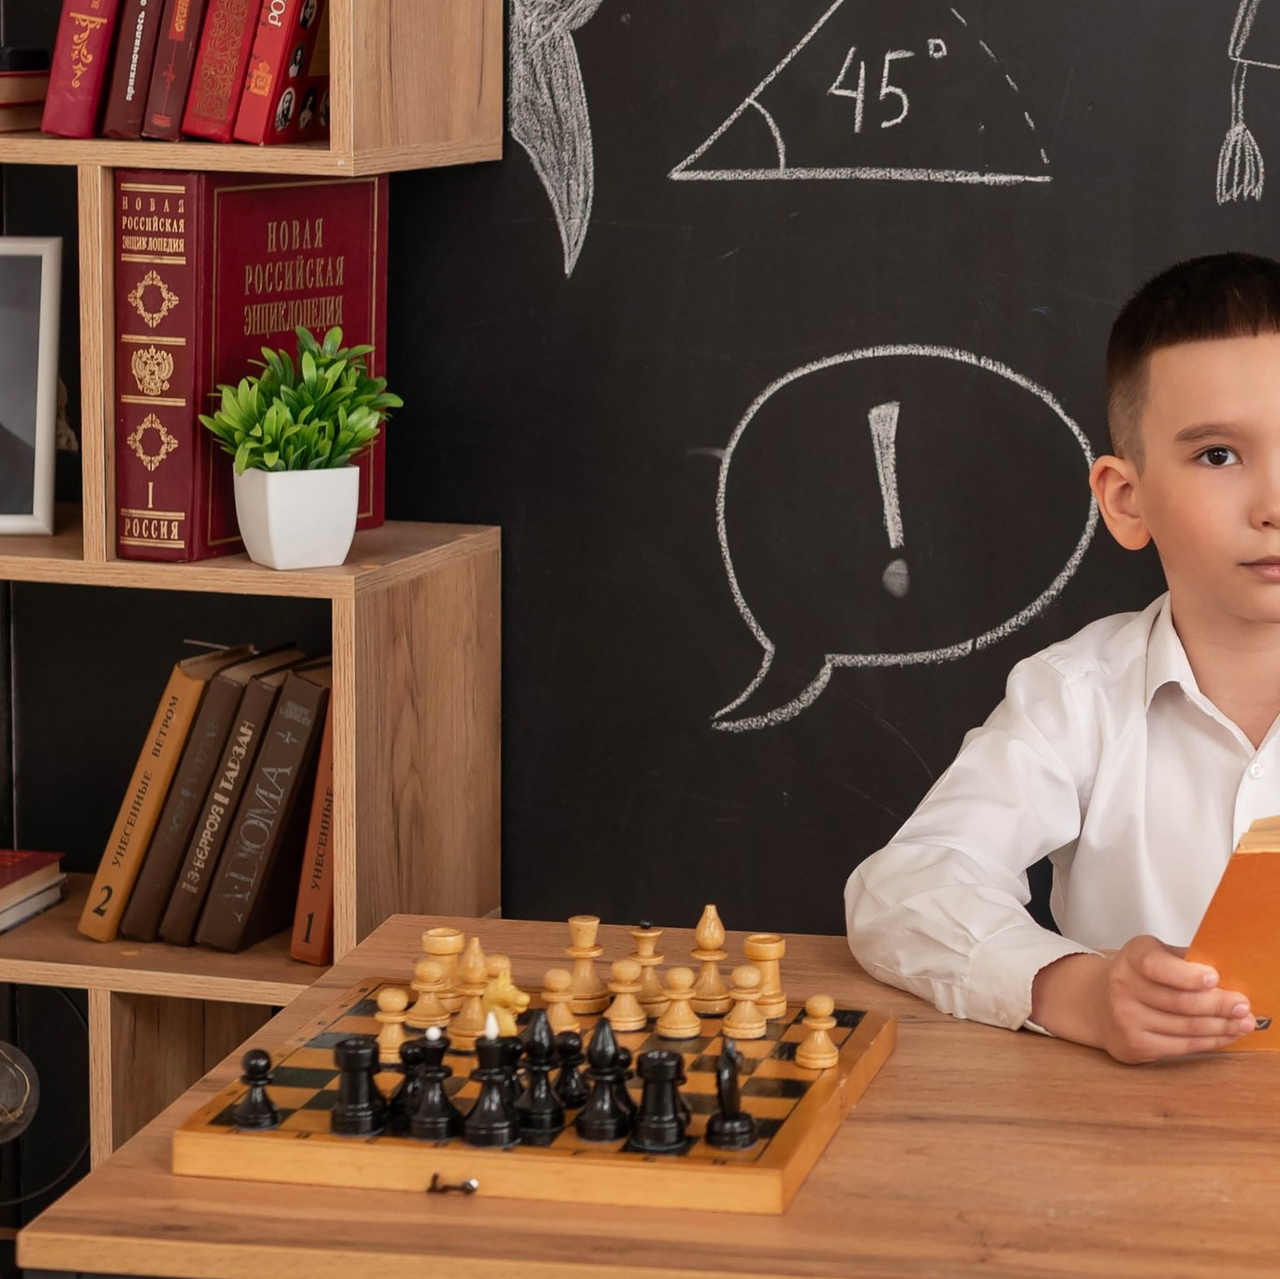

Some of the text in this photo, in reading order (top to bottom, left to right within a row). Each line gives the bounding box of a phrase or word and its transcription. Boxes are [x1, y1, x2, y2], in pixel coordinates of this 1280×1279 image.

[125, 10, 145, 102] приключилось
[122, 195, 185, 214] НОВАЯ
[121, 215, 185, 234] РОССИЙСКАЯ
[266, 217, 324, 254] НОВАЯ
[121, 235, 185, 254] ЭНЦИКЛОПЕДИЯ
[243, 254, 345, 296] РОССИЙСКАЯ
[243, 295, 344, 338] ЭНЦИКЛОПЕДИЯ
[124, 518, 179, 540] РОССИЯ
[112, 694, 180, 868] УНЕСЕННЫЕ ВЕТРОМ
[310, 785, 334, 891] УНЕСЕННЫЕ
[92, 884, 114, 918] 2
[302, 911, 315, 945] 1
